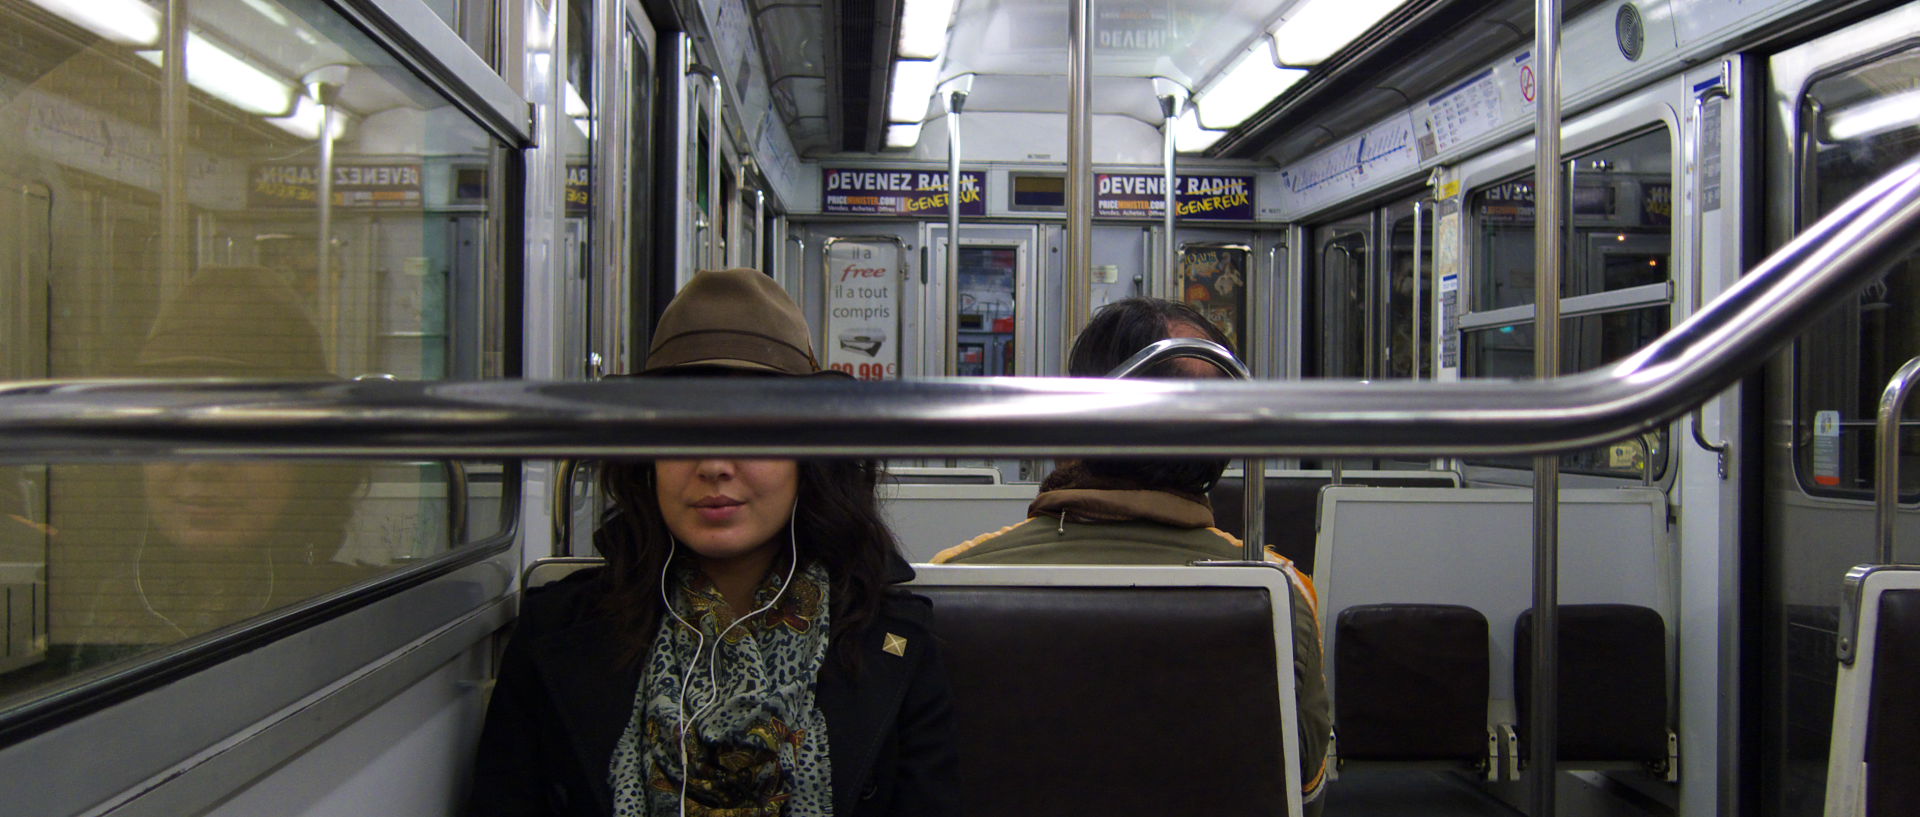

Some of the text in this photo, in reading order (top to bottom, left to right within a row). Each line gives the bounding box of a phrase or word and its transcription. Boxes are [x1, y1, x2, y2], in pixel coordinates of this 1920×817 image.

[827, 172, 980, 192] DEVENEZ RAN.
[1187, 177, 1248, 196] RADIN.
[908, 190, 980, 212] GENEUX
[841, 264, 887, 282] free
[835, 285, 888, 298] il a tout
[832, 304, 890, 320] compris
